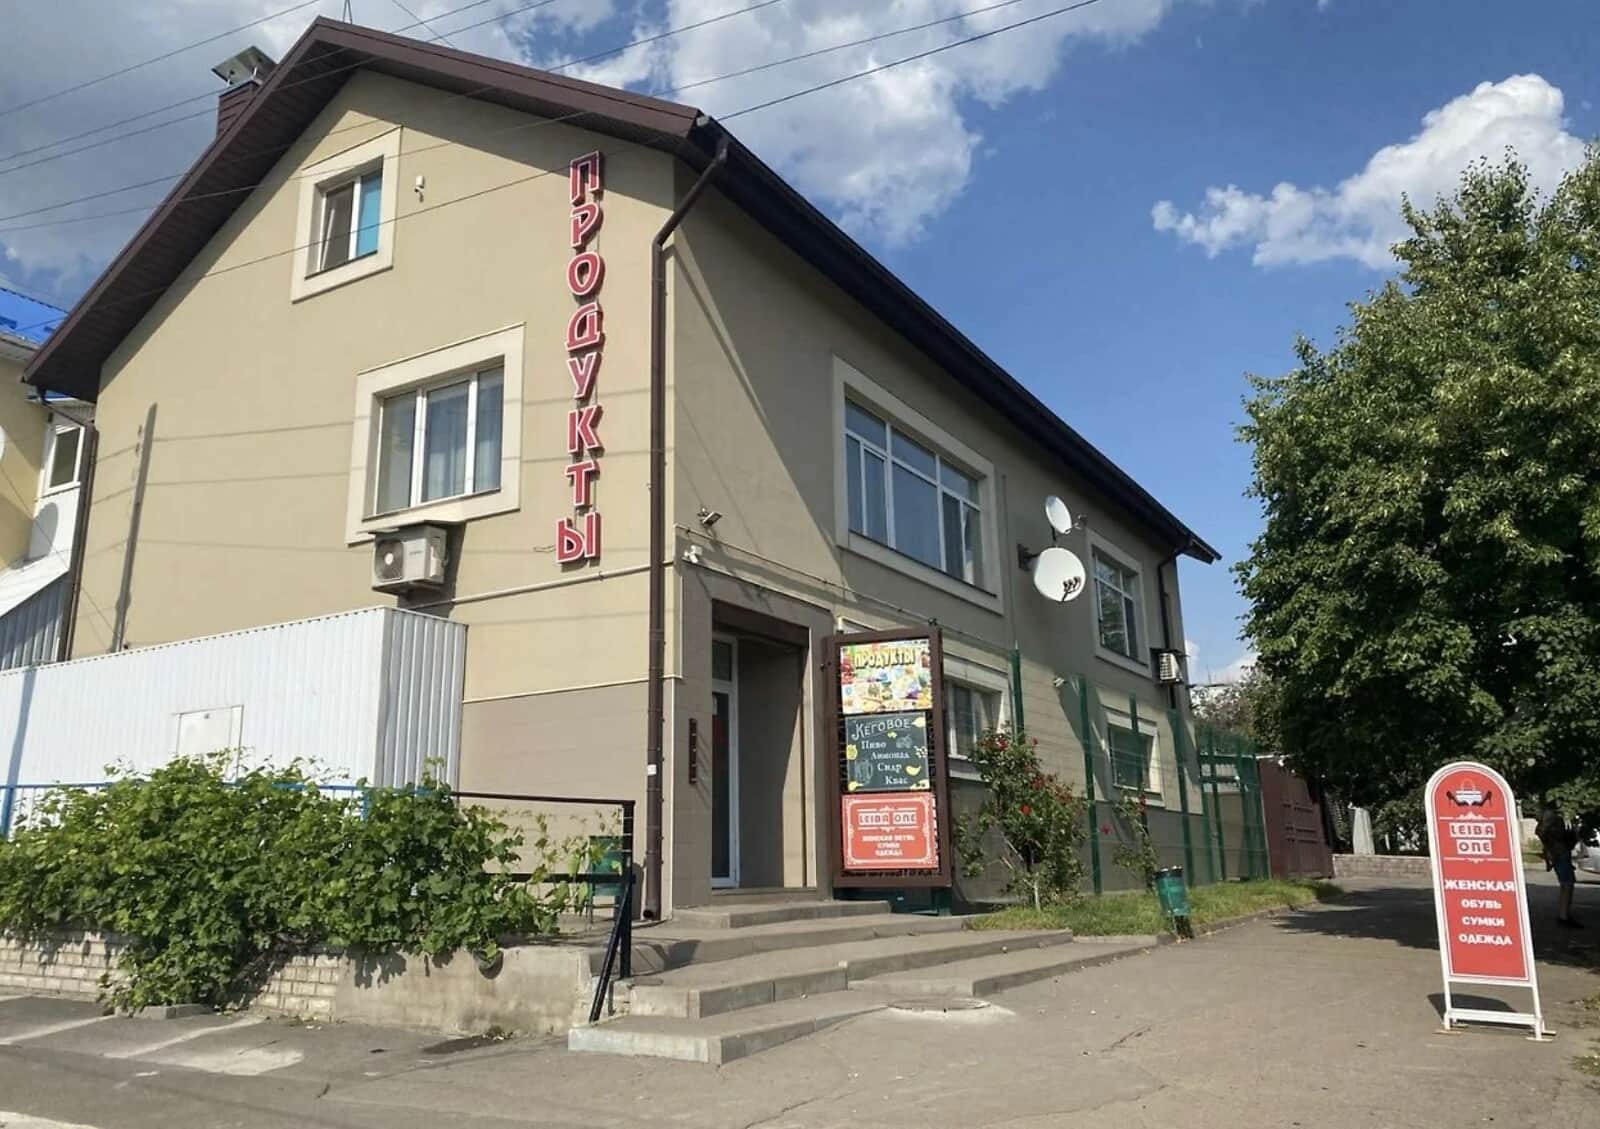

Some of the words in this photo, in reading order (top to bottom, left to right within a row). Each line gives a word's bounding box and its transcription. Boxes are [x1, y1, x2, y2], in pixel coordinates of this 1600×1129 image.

[556, 150, 601, 564] ПРОДУКТЫ
[854, 646, 916, 669] ПРОДУКТЫ
[861, 740, 887, 750] Пиво
[877, 762, 902, 774] Сидр
[885, 775, 909, 785] Квас
[1450, 824, 1495, 837] LEIBA
[1457, 841, 1491, 853] ONE
[1444, 879, 1515, 891] ЖЕНСКАЯ
[1461, 898, 1502, 909] ОБУВЬ
[1462, 916, 1505, 927] СУМКИ
[1458, 933, 1512, 946] ОДЕЖДА
